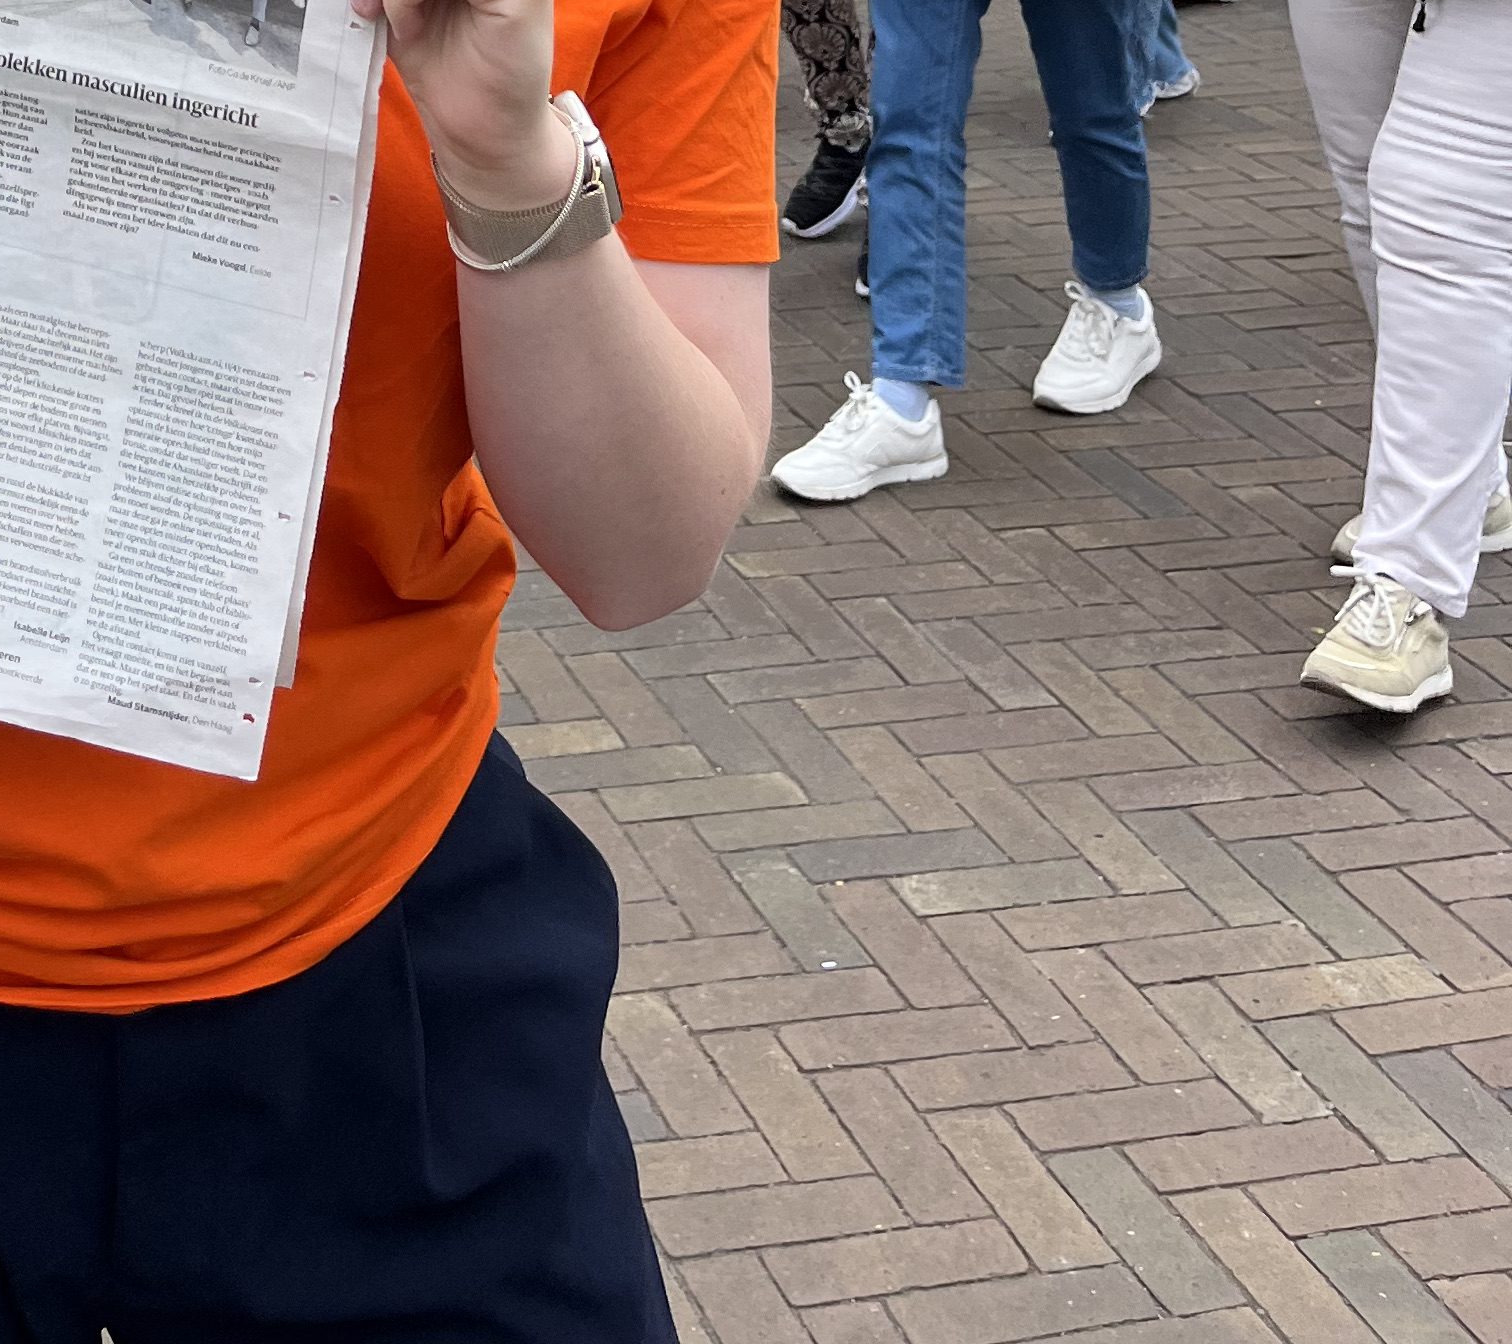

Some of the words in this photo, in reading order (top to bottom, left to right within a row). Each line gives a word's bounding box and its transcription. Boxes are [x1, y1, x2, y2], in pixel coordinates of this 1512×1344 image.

[71, 72, 167, 107] masculien
[171, 92, 257, 129] ingericht
[107, 694, 133, 709] Maud
